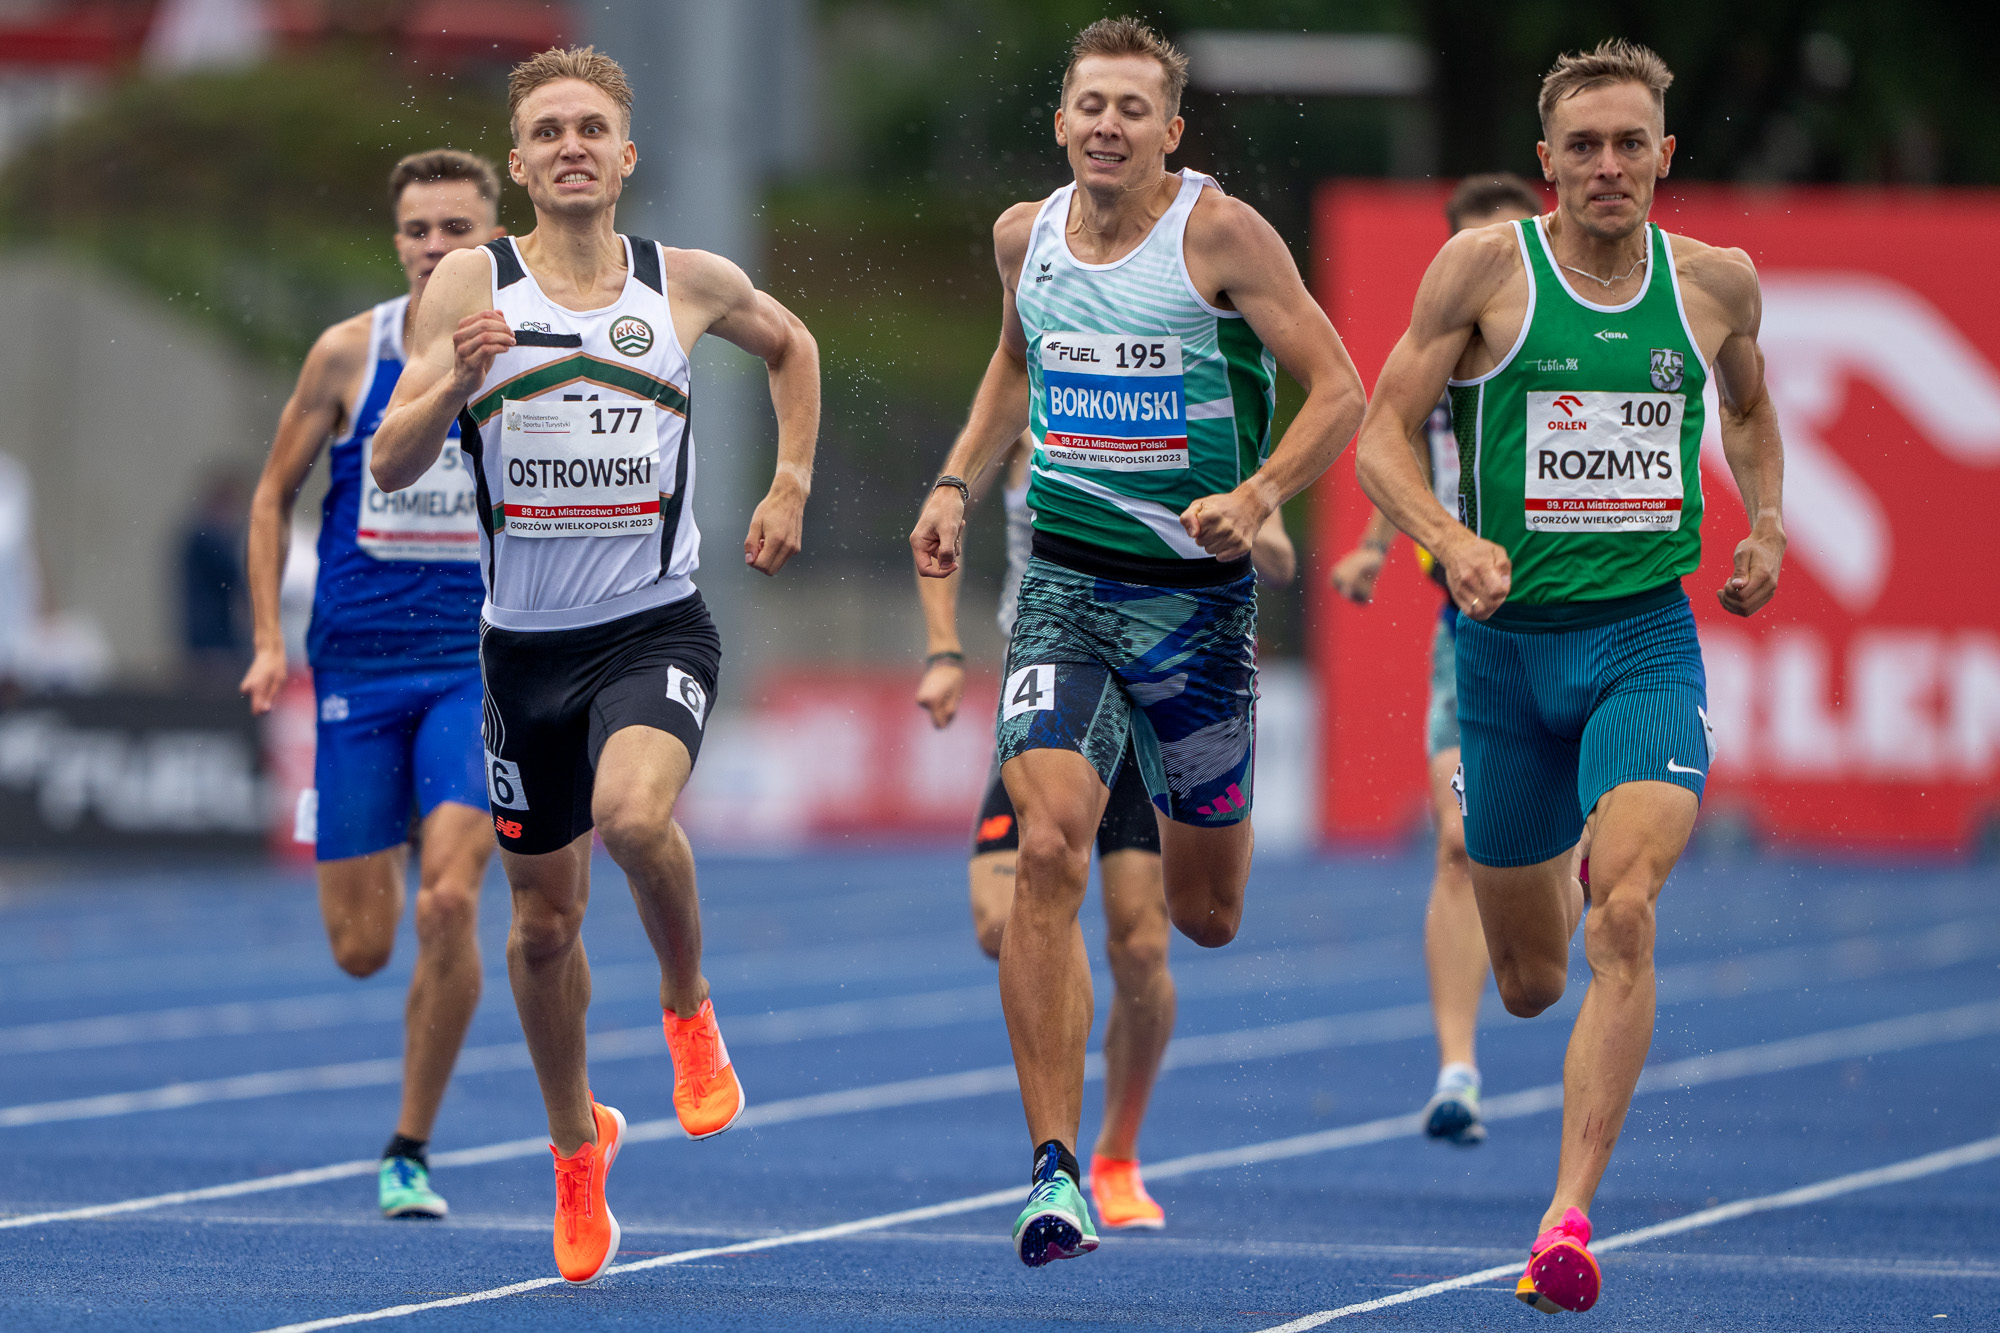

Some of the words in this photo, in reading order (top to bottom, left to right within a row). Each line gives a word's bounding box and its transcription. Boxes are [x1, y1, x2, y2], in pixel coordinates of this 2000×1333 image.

[615, 322, 646, 339] RKS
[1605, 332, 1629, 340] IBRA
[1115, 342, 1167, 369] 195
[1050, 385, 1179, 422] BORKOWSKI
[589, 408, 643, 435] 177
[1620, 400, 1672, 427] 100
[522, 421, 541, 429] Sportu
[545, 421, 571, 429] Turystyki
[1547, 421, 1587, 431] ORLEN
[1061, 437, 1072, 446] 99.
[1072, 438, 1090, 448] PZLA
[1091, 439, 1138, 450] Mistrzostwa
[1140, 440, 1168, 449] Polski
[1050, 450, 1087, 462] GORZÓW
[1088, 454, 1155, 464] WIELKOPOLSKI
[1156, 453, 1181, 463] 2023
[1538, 449, 1673, 480] ROZMYS
[508, 456, 652, 489] OSTROWSKI
[521, 507, 534, 517] 99.
[535, 508, 557, 518] PZLA
[558, 506, 613, 517] Mistrzostwa
[615, 505, 641, 515] Polski
[1546, 501, 1561, 510] 99.
[1563, 501, 1585, 510] PZLA
[1587, 500, 1641, 510] Mistrzostwa
[1642, 500, 1667, 510] Polski
[510, 521, 552, 531] GORZÓW
[554, 519, 628, 530] WIELKOPOLSKI
[629, 518, 653, 528] 2023
[1532, 515, 1582, 524] GORZÓW
[1583, 515, 1654, 524] WIELKOPOLSKI
[1655, 515, 1674, 524] 2023
[680, 676, 701, 713] 6
[1012, 668, 1043, 707] 4
[492, 760, 515, 805] 6
